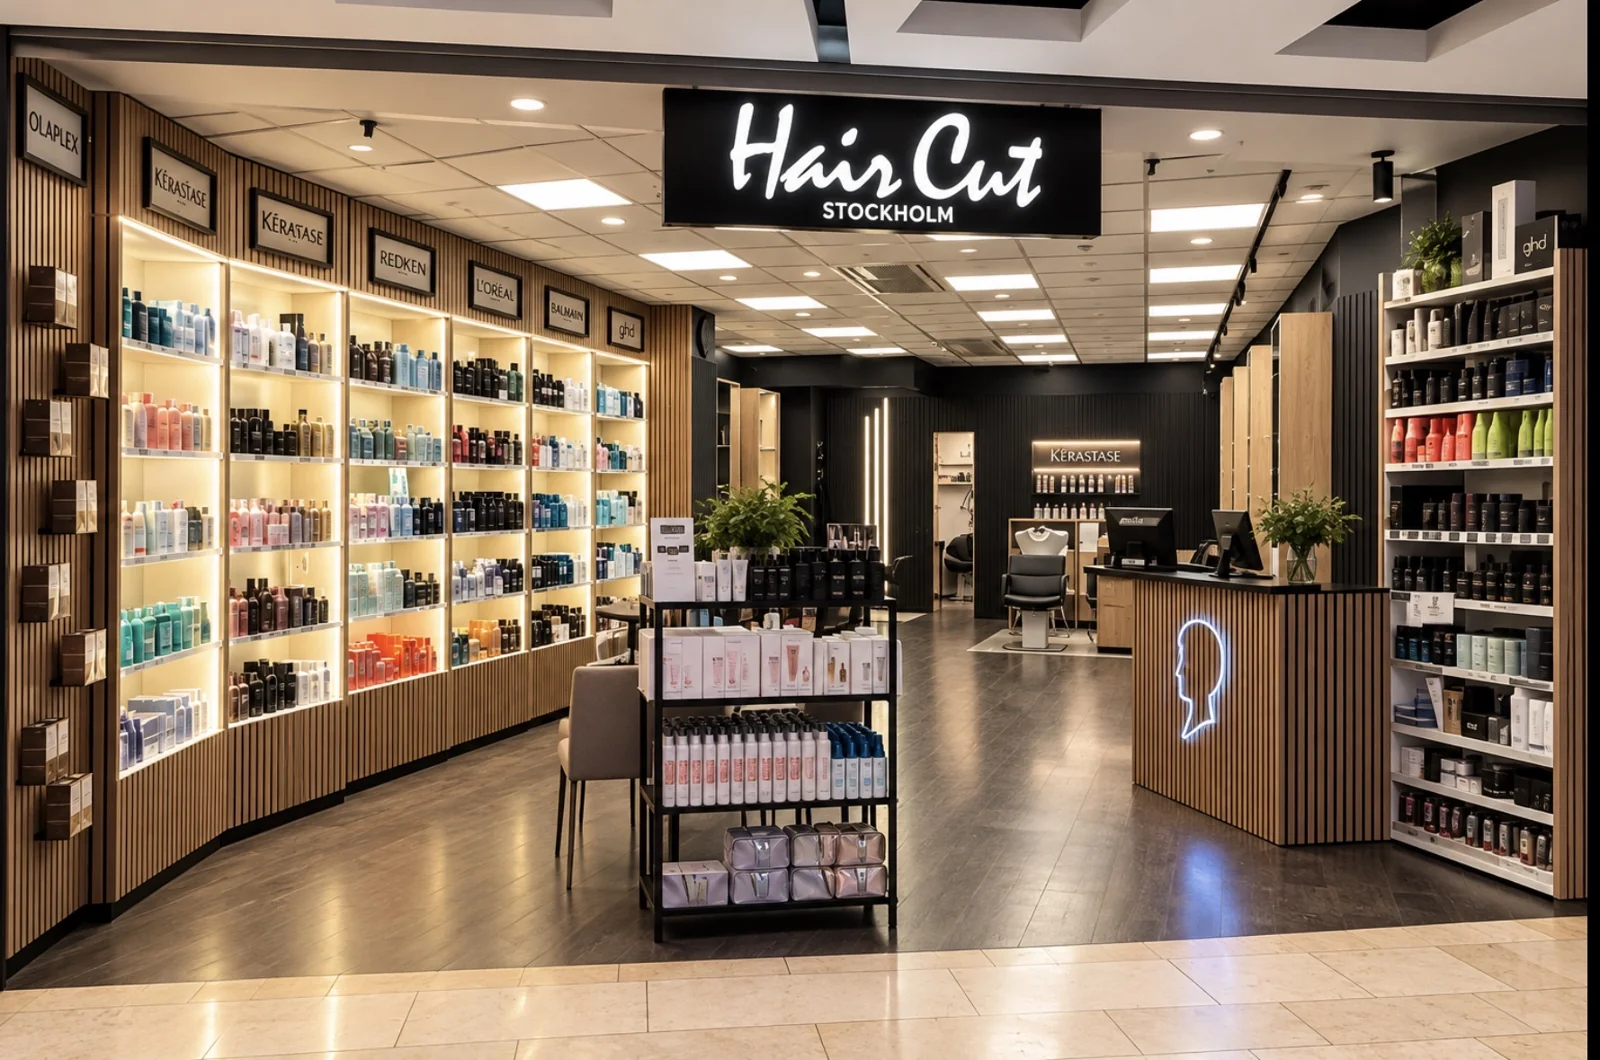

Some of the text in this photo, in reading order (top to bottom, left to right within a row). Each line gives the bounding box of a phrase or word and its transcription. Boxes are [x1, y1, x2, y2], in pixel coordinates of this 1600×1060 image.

[29, 110, 79, 155] OLAPLEX
[729, 102, 1043, 208] Hair Cut
[822, 201, 954, 224] STOCKHOLM
[1523, 233, 1547, 257] ghd
[380, 250, 427, 276] REDKEN
[550, 302, 584, 321] BALMAIN
[618, 321, 635, 340] ghd
